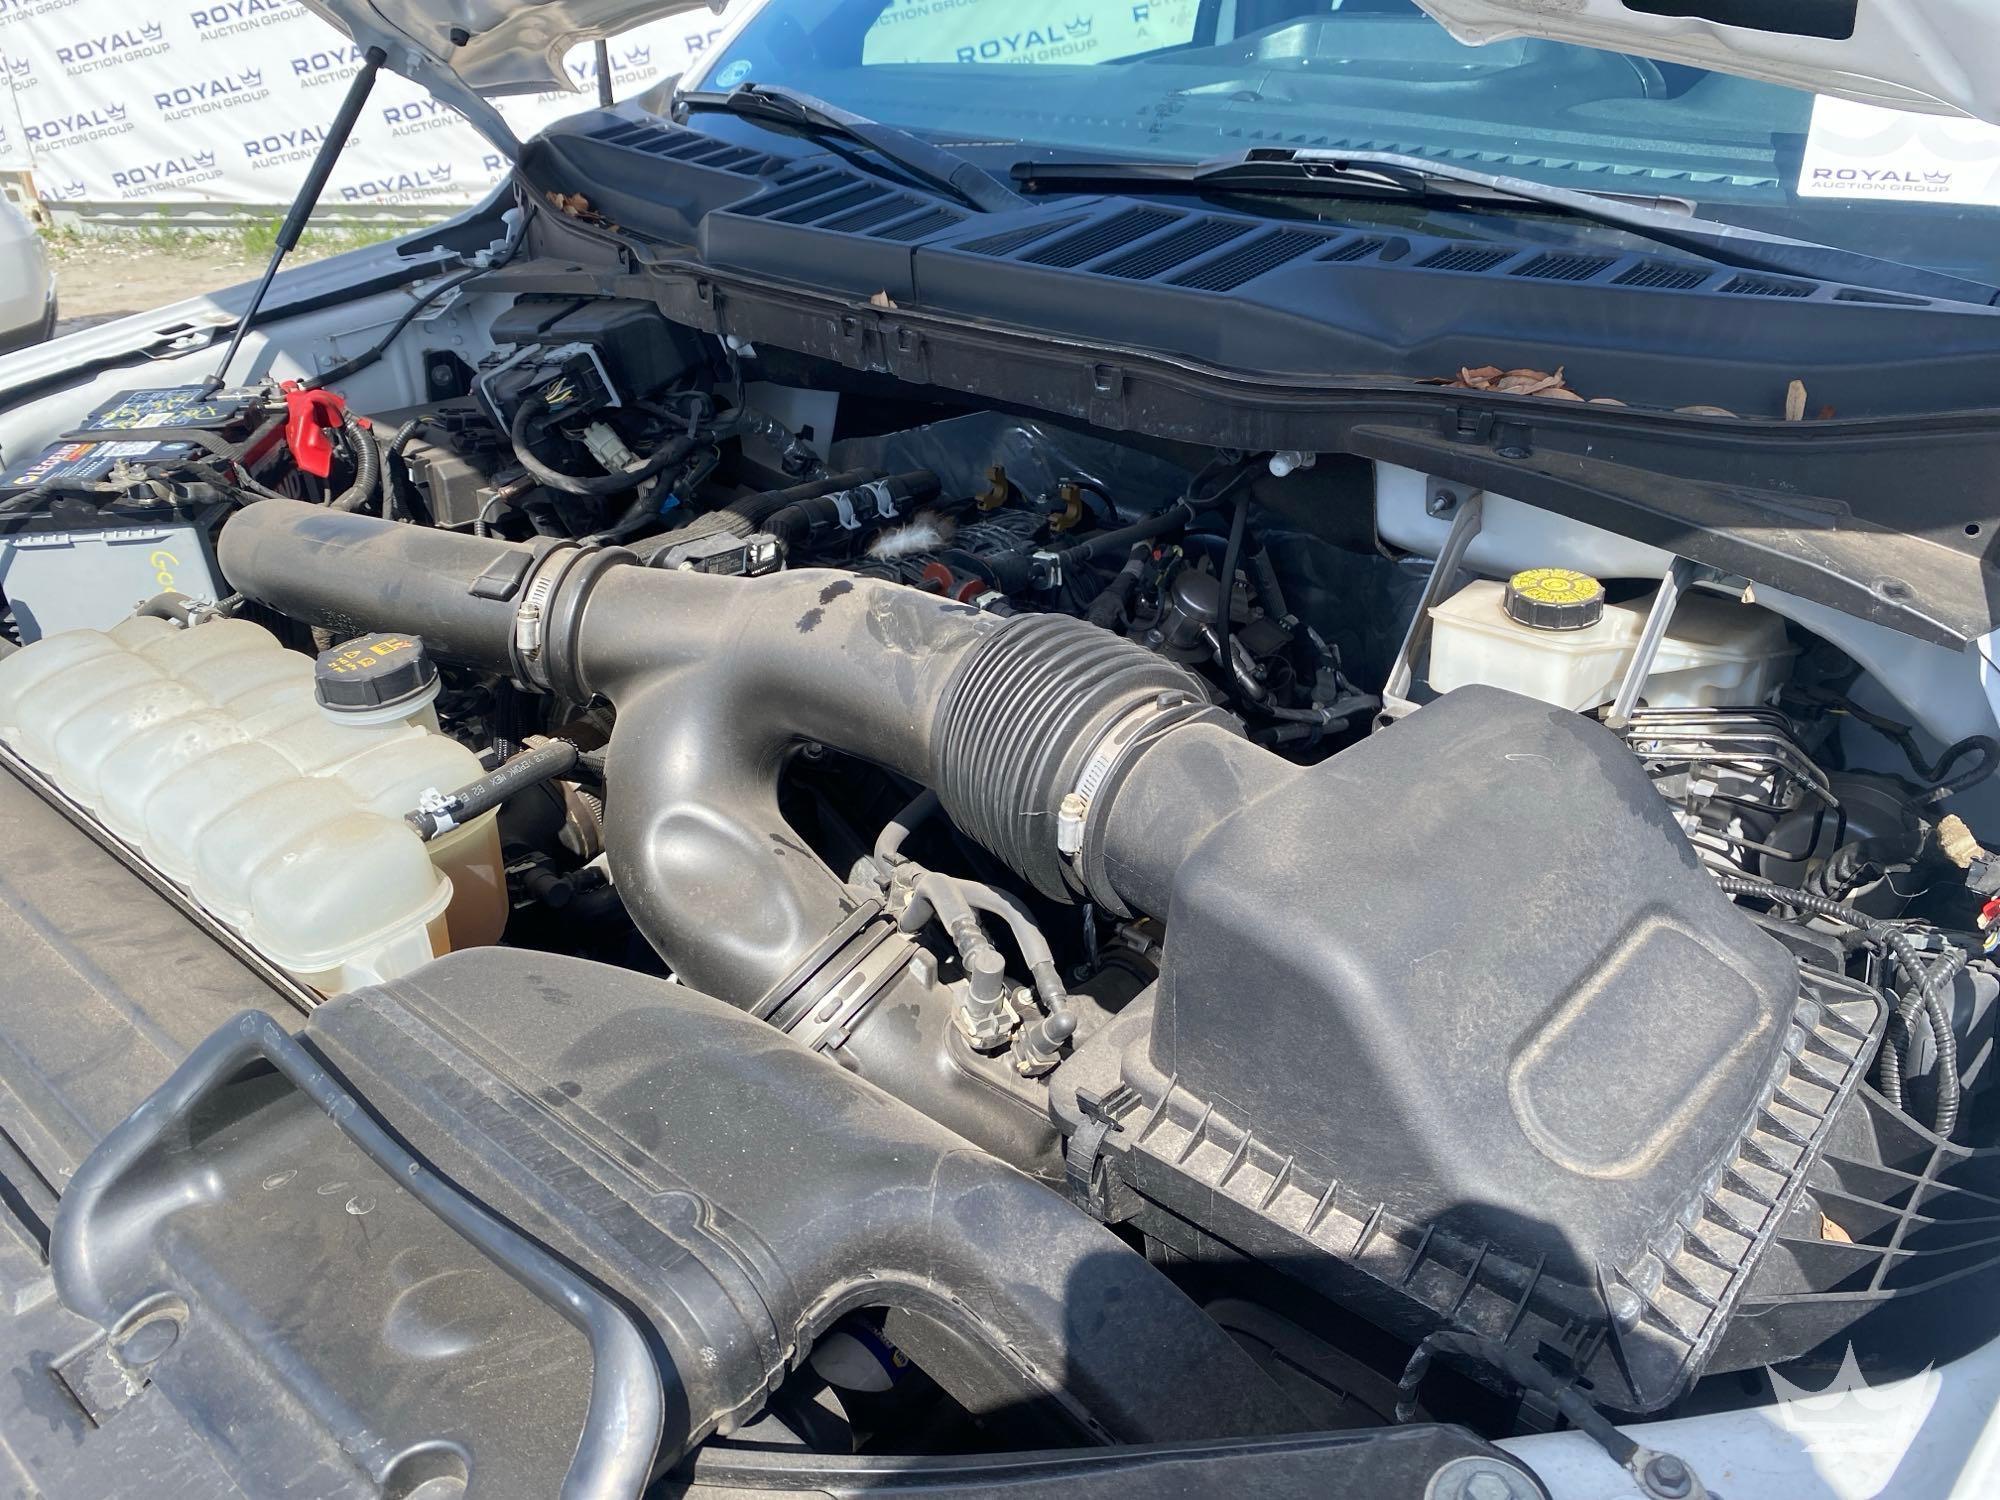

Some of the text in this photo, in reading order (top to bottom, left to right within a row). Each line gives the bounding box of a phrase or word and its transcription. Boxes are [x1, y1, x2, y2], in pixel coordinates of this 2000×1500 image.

[0, 9, 34, 26] CTION
[190, 0, 281, 28] ROYAL
[200, 7, 309, 41] AUCTION GROUP
[876, 6, 930, 27] CTION
[56, 30, 143, 64] ROYAL
[66, 42, 171, 77] AUCTION GROUP
[291, 45, 362, 75] ROYA
[957, 27, 1065, 63] ROYAL
[1038, 39, 1098, 61] GROUP
[612, 67, 657, 87] ROUP
[154, 76, 243, 109] ROYAL
[164, 88, 270, 122] AUCTION GROUP
[25, 110, 108, 141] ROYAL
[383, 99, 447, 125] ROY
[392, 115, 452, 137] AUCTION
[35, 122, 135, 153] AUCTION GROUP
[243, 125, 327, 157] ROYAL
[112, 157, 196, 188] ROYAL
[252, 149, 312, 170] AUCTION
[122, 169, 224, 200] AUCTION GROUP
[341, 171, 430, 201] ROYAL
[1811, 181, 1950, 193] AUCTION GROUP
[1813, 168, 1921, 182] ROYAL
[411, 183, 458, 200] GROUP
